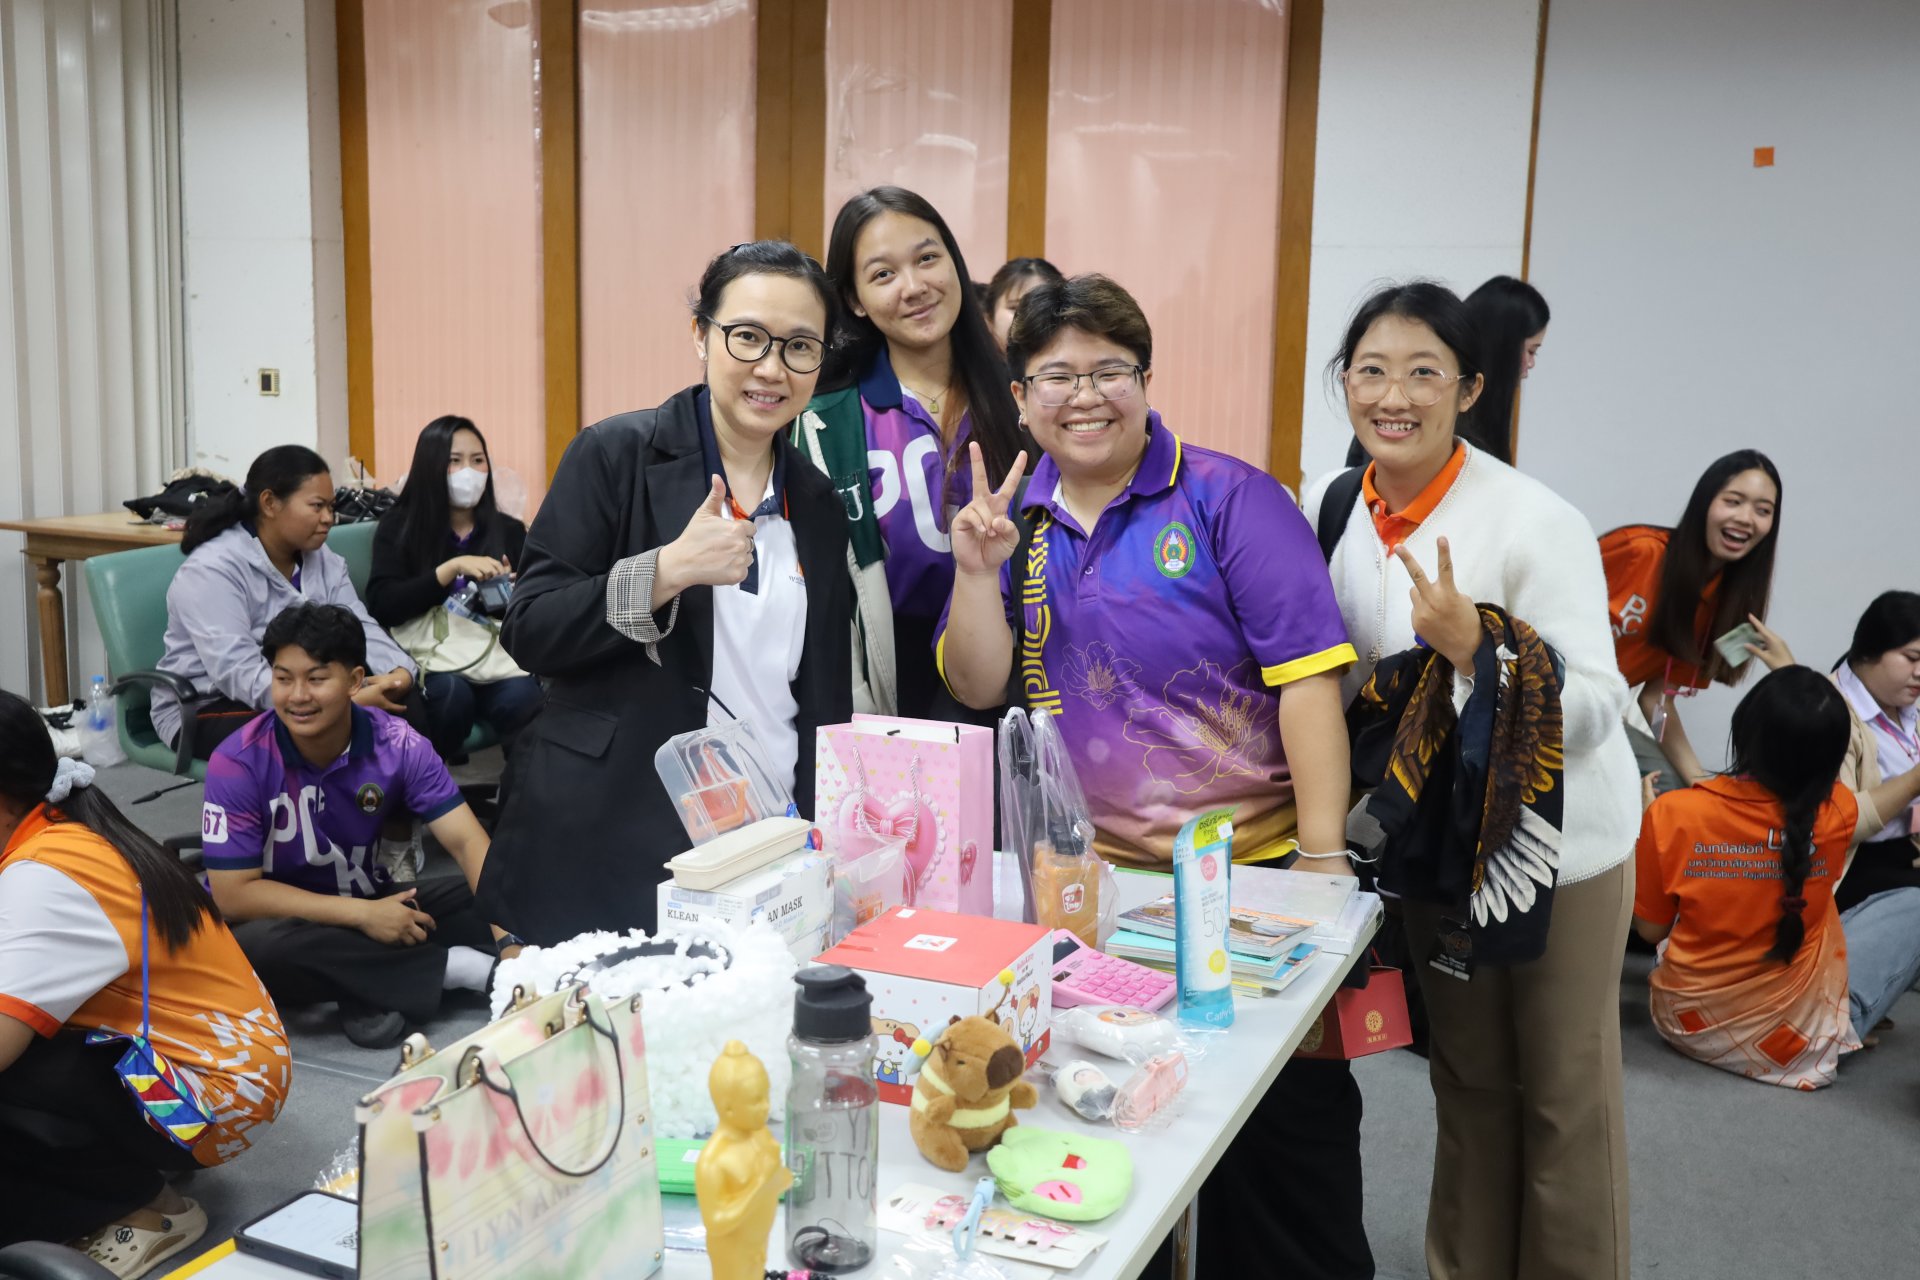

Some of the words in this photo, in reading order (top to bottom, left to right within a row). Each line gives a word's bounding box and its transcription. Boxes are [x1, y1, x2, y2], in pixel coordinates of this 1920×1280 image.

[203, 808, 223, 836] 67
[666, 908, 700, 923] KLEAN
[780, 895, 804, 917] MASK
[1203, 906, 1224, 938] 50
